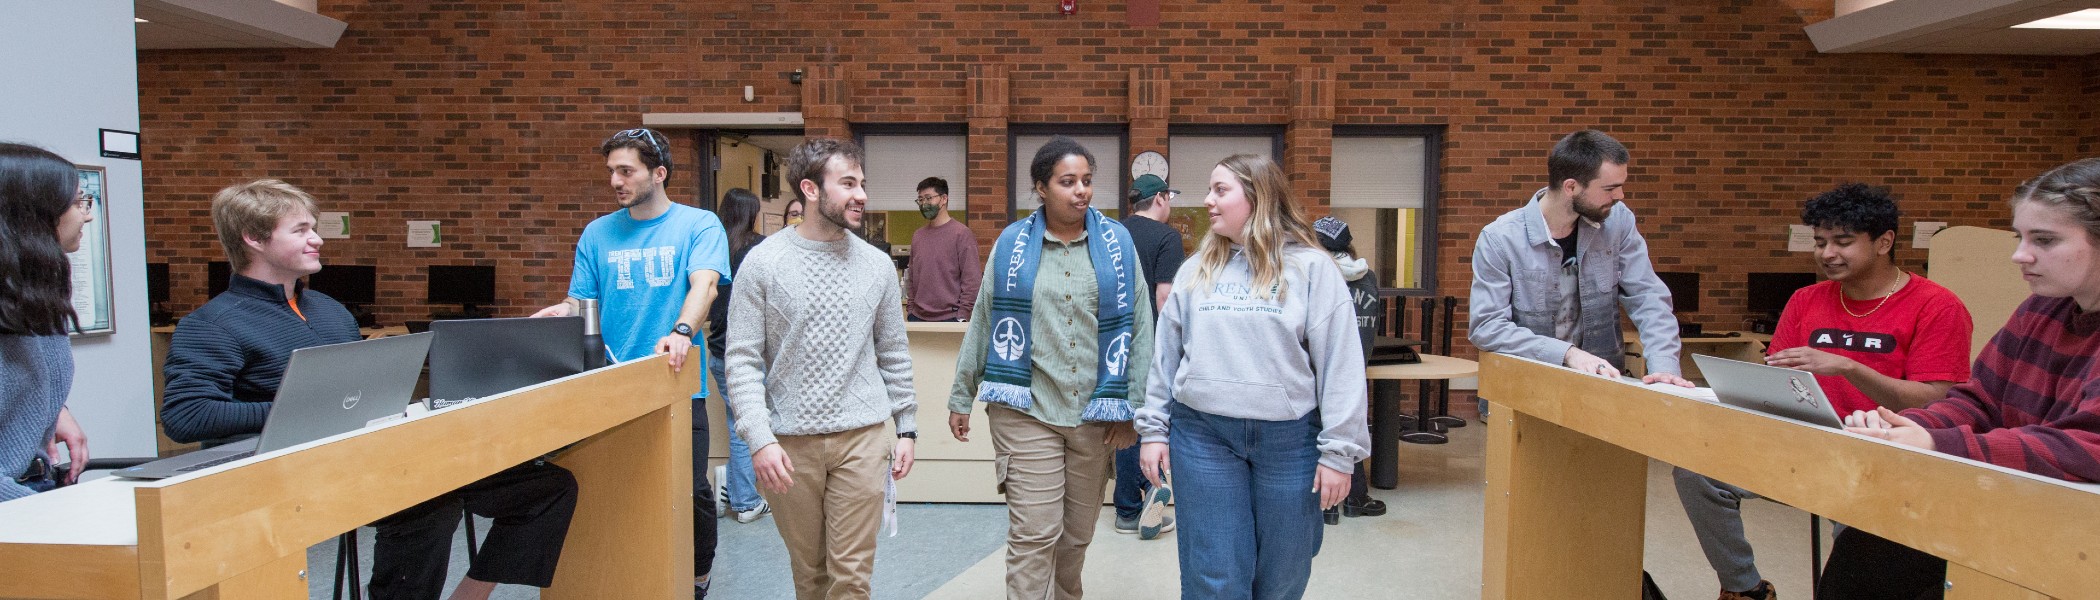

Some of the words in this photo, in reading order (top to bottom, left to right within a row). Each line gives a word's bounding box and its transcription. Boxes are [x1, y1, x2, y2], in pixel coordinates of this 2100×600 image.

[608, 246, 676, 290] TU
[1007, 228, 1030, 292] TRENT
[1103, 229, 1128, 310] DURHAM
[1211, 283, 1259, 297] REN
[1347, 287, 1377, 310] NT
[1356, 316, 1376, 328] SITY
